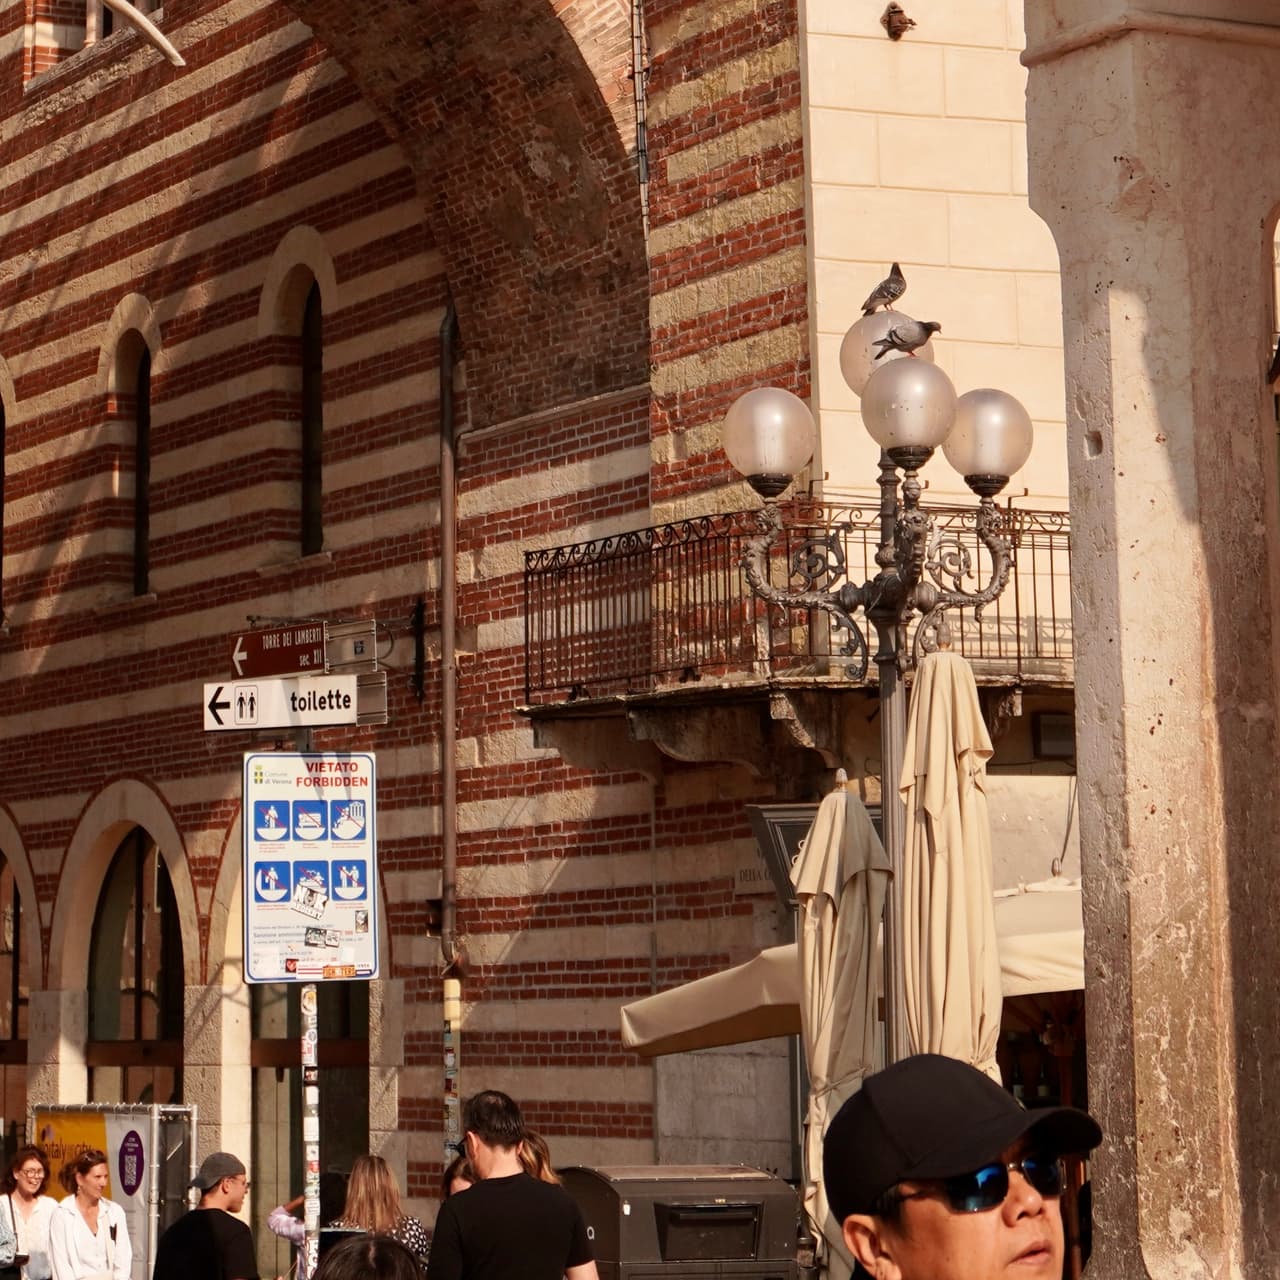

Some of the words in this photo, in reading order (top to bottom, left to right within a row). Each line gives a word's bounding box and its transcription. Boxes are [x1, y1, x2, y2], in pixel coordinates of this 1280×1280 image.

[262, 634, 280, 650] TORRE
[283, 632, 292, 647] DEI
[295, 628, 322, 646] LAMBERTI
[313, 649, 322, 665] XII
[290, 689, 351, 712] toilette
[305, 762, 358, 773] VIETATO
[296, 777, 368, 787] FORBIDDEN
